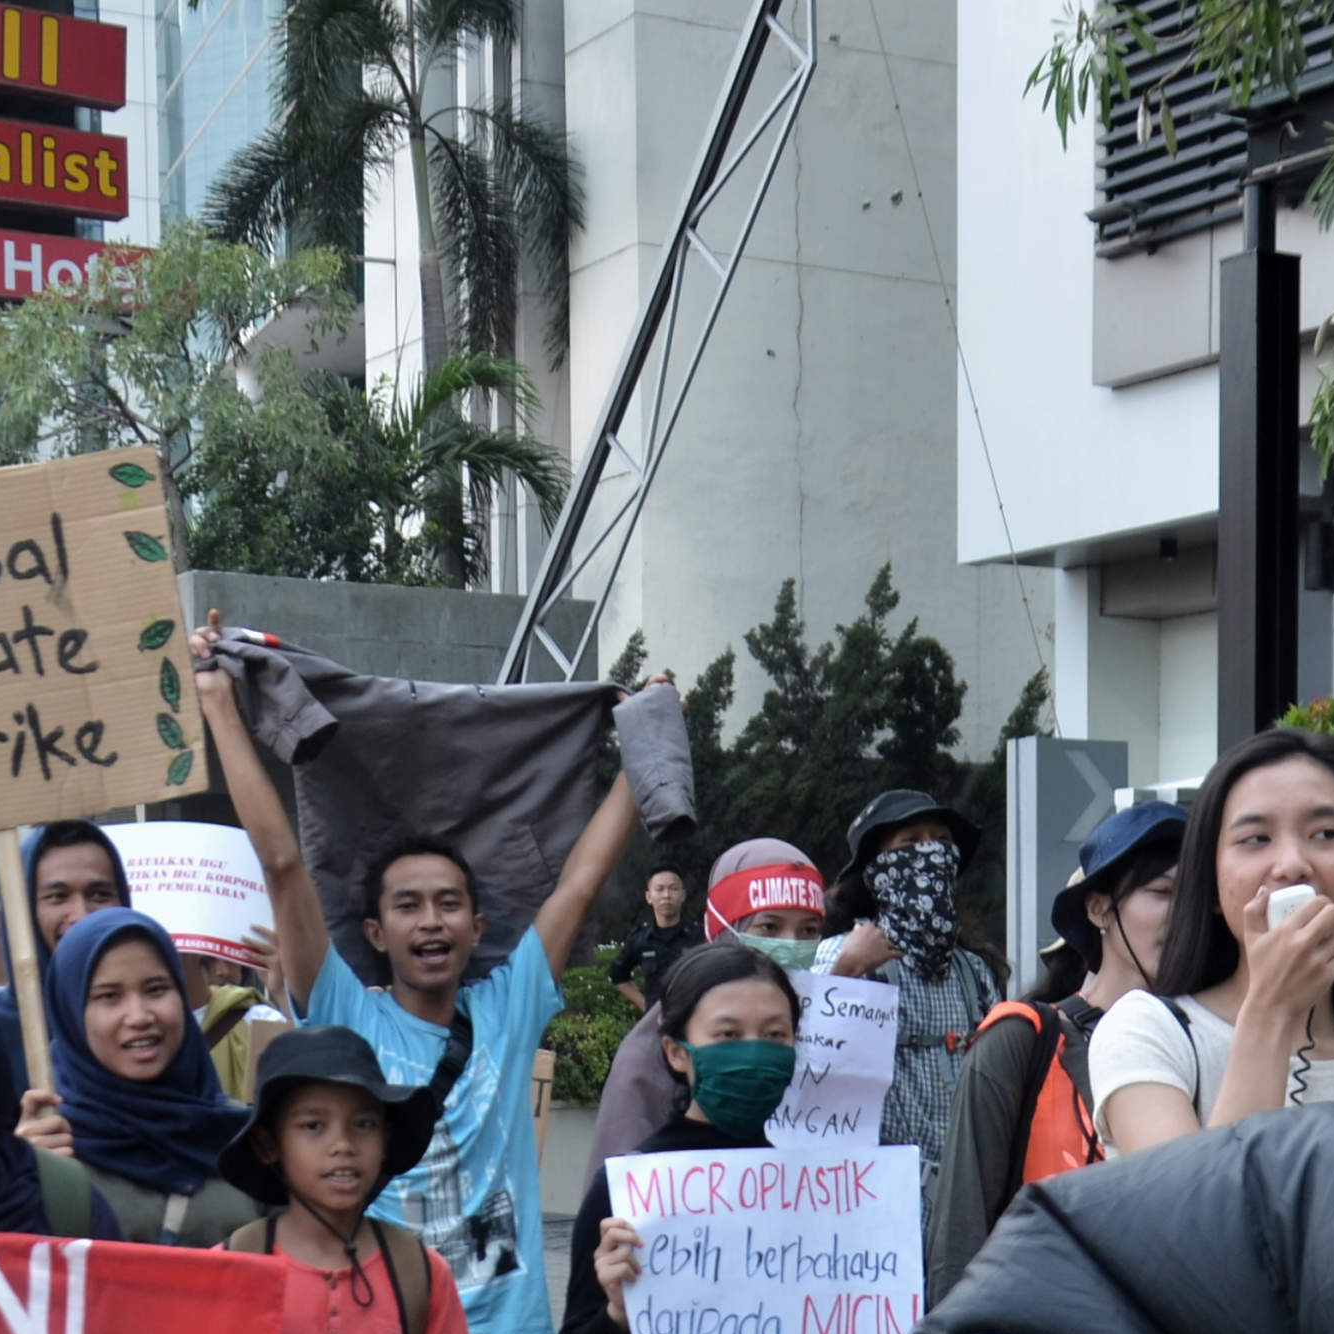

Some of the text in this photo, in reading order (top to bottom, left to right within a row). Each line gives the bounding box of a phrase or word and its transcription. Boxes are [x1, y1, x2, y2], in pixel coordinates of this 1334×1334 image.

[205, 871, 269, 894] KORPORA
[749, 877, 807, 909] CLIMATE
[625, 1158, 878, 1218] MICROPLASTIK
[643, 1225, 898, 1284] ebih berbahaya
